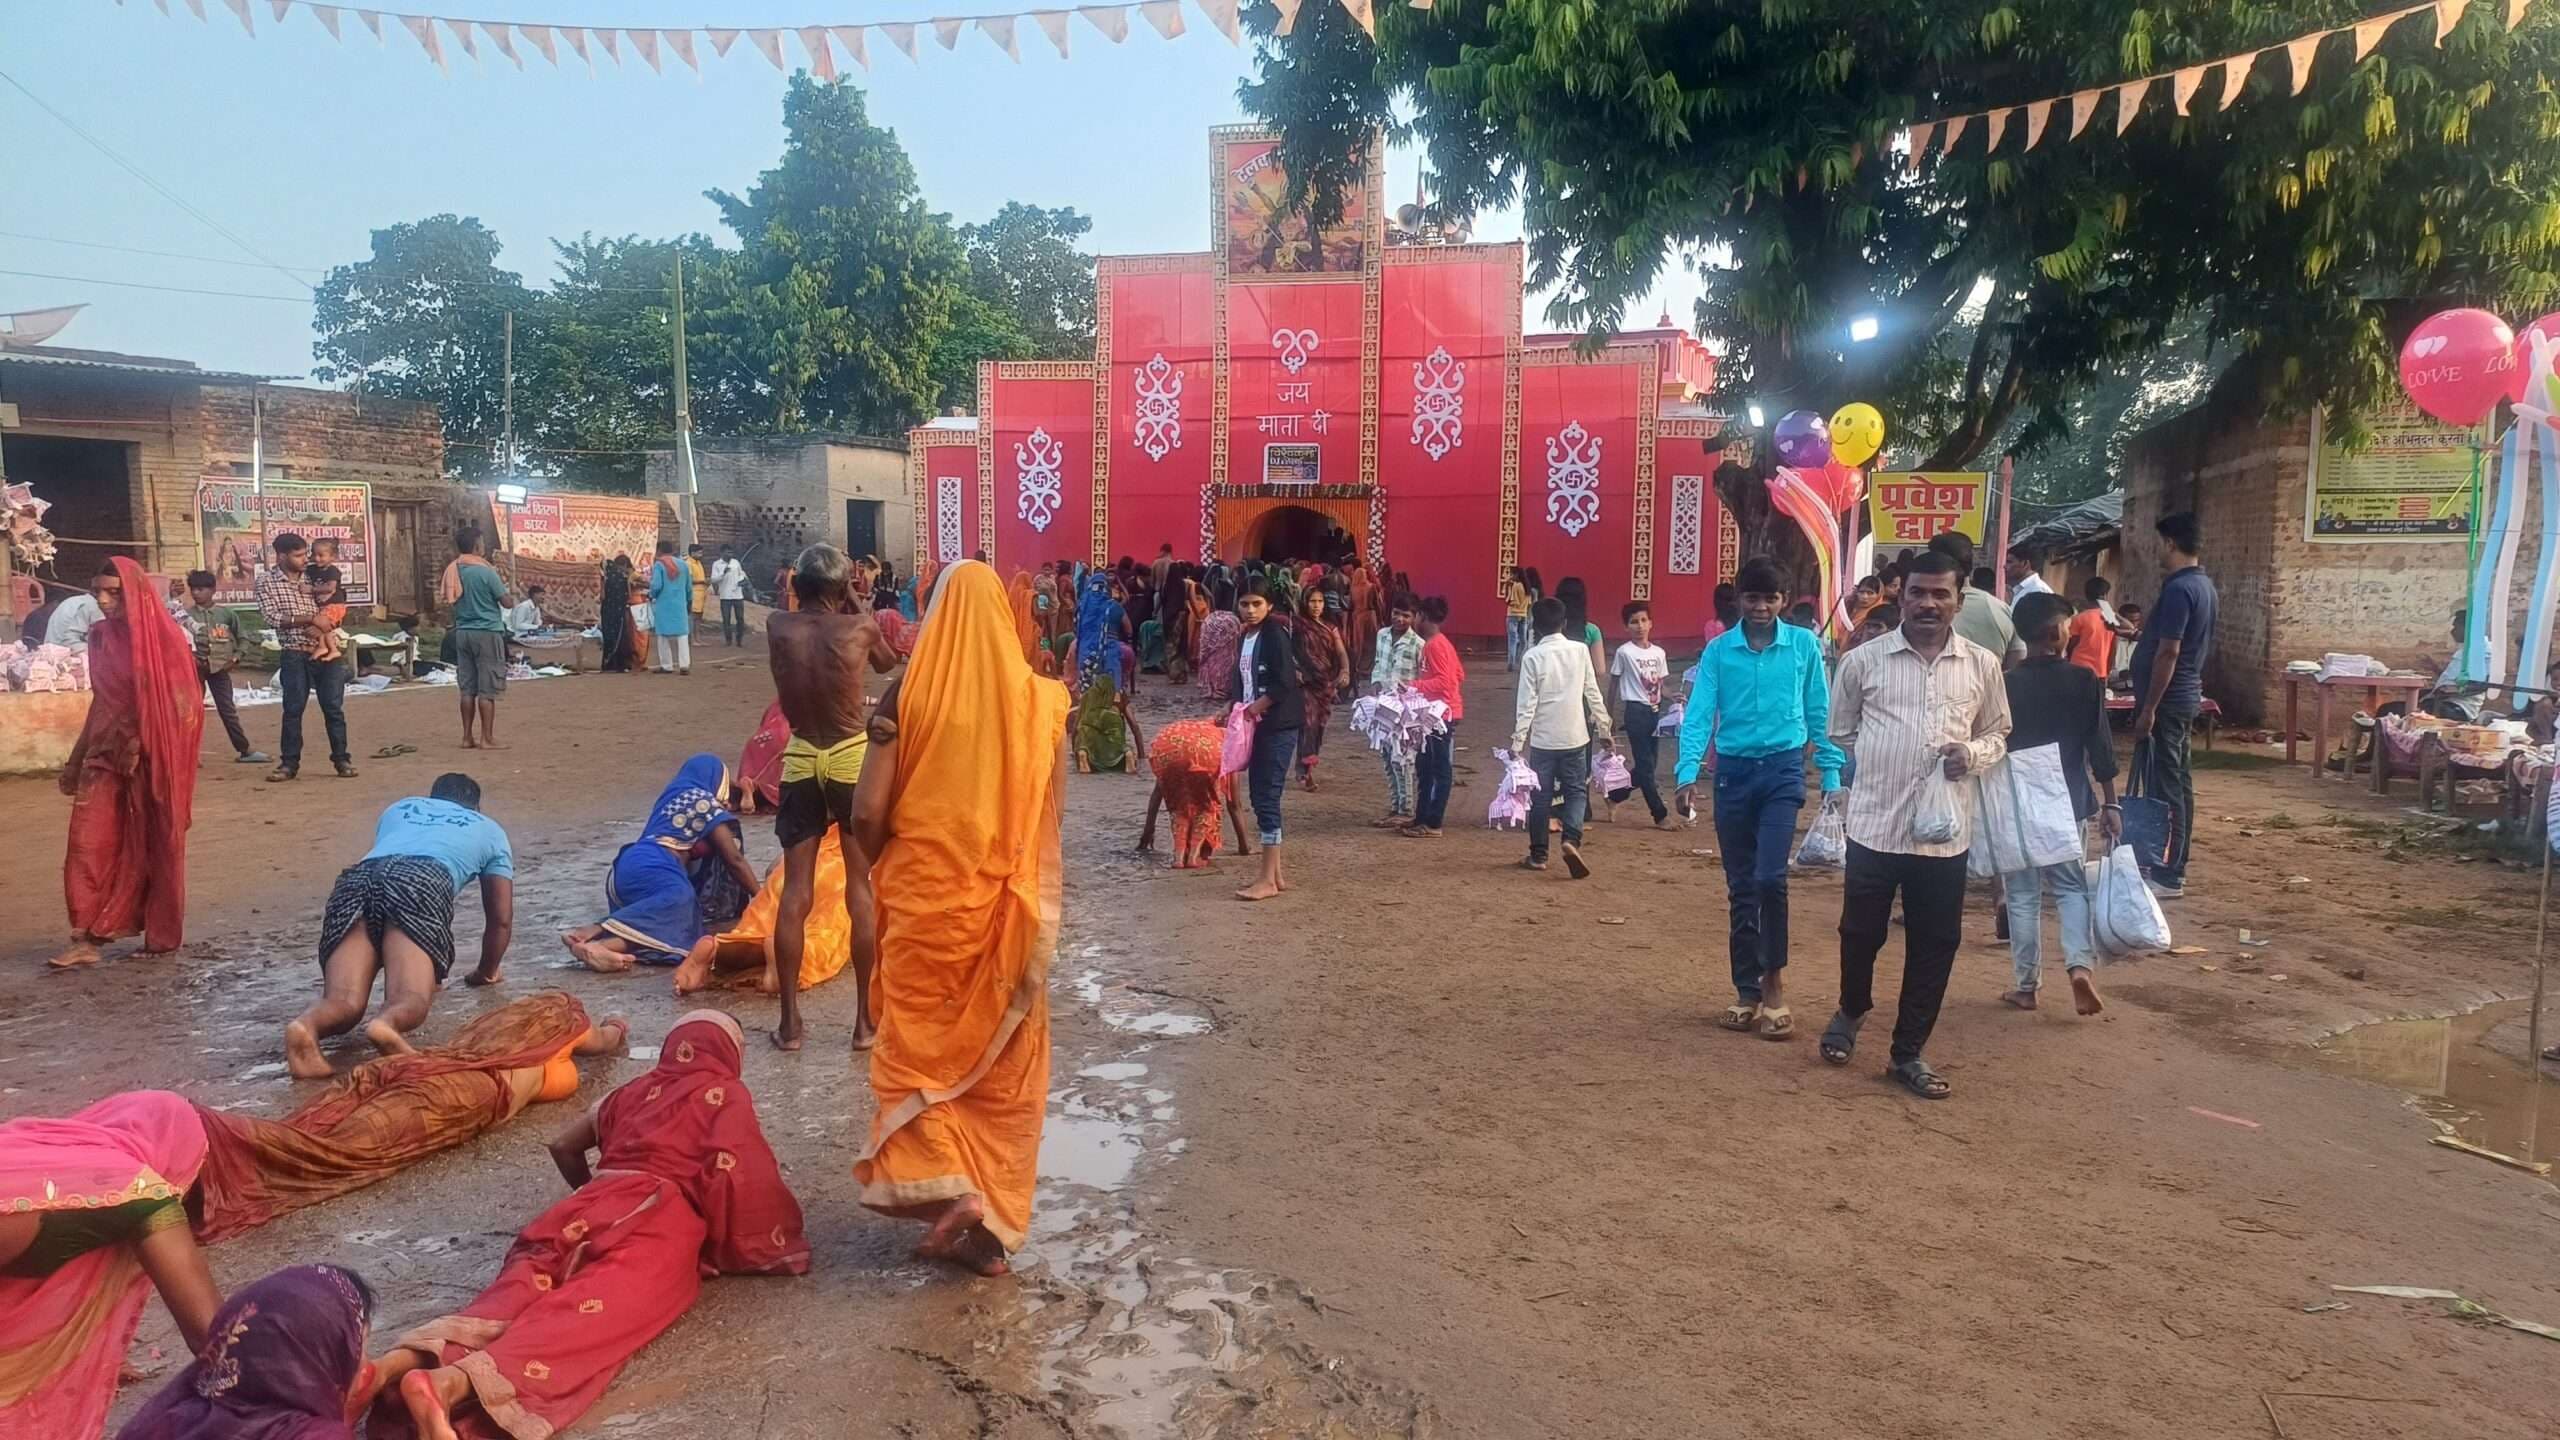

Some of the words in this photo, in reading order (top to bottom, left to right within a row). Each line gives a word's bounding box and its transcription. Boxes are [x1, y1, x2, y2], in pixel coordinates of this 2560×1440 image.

[2407, 366, 2463, 389] LOVE
[1277, 382, 1312, 404] जय
[1256, 414, 1304, 437] माता
[1311, 408, 1332, 436] दी
[1878, 475, 1979, 511] प्रवेश
[1892, 513, 1960, 540] द्वार
